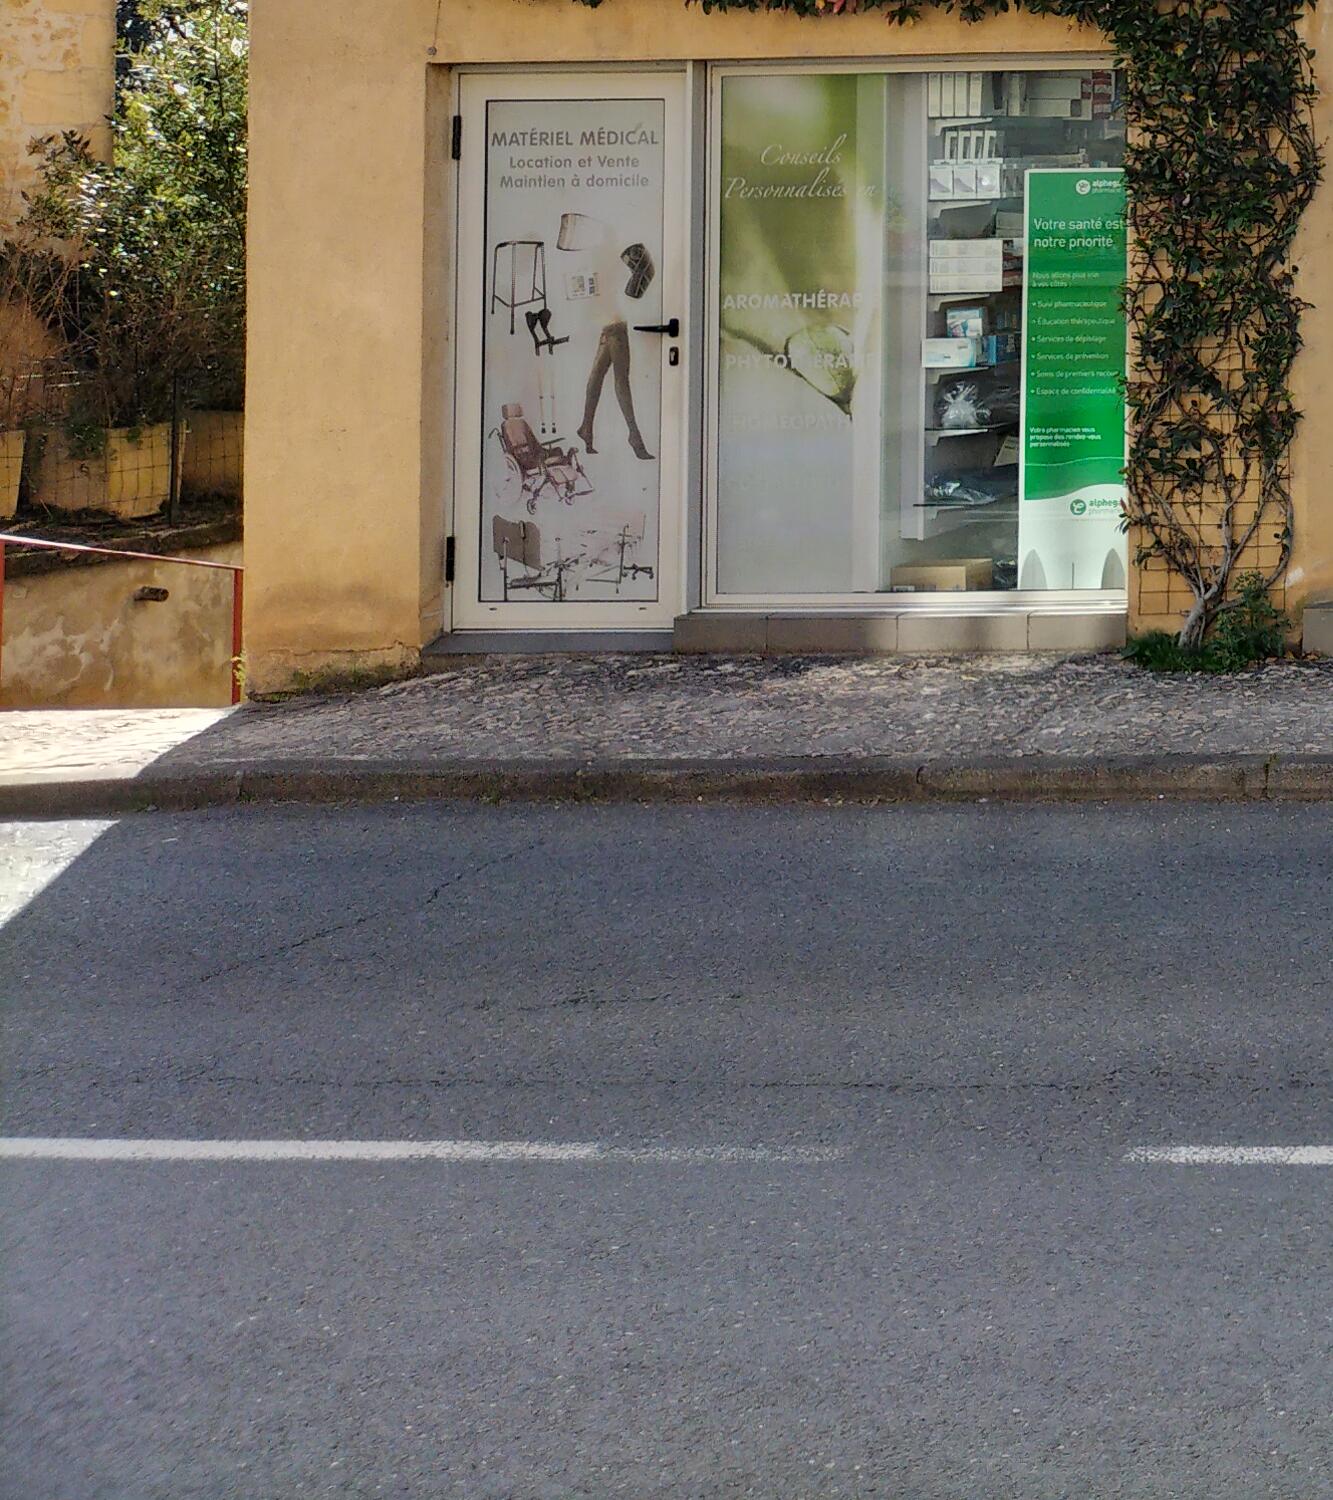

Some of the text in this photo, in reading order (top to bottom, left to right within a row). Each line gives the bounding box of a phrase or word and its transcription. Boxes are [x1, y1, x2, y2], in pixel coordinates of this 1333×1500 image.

[491, 127, 659, 146] MATÉRIEL MÉDICAL
[761, 133, 847, 165] Conseils
[510, 155, 640, 168] Location et Vente
[500, 174, 650, 188] Maintien à domicile
[724, 167, 847, 199] Personnalisés
[1033, 217, 1124, 230] Votre santé est
[1033, 234, 1114, 250] notre priorité
[723, 289, 879, 309] AROMATHÉRAPE
[1089, 499, 1119, 507] alpheg
